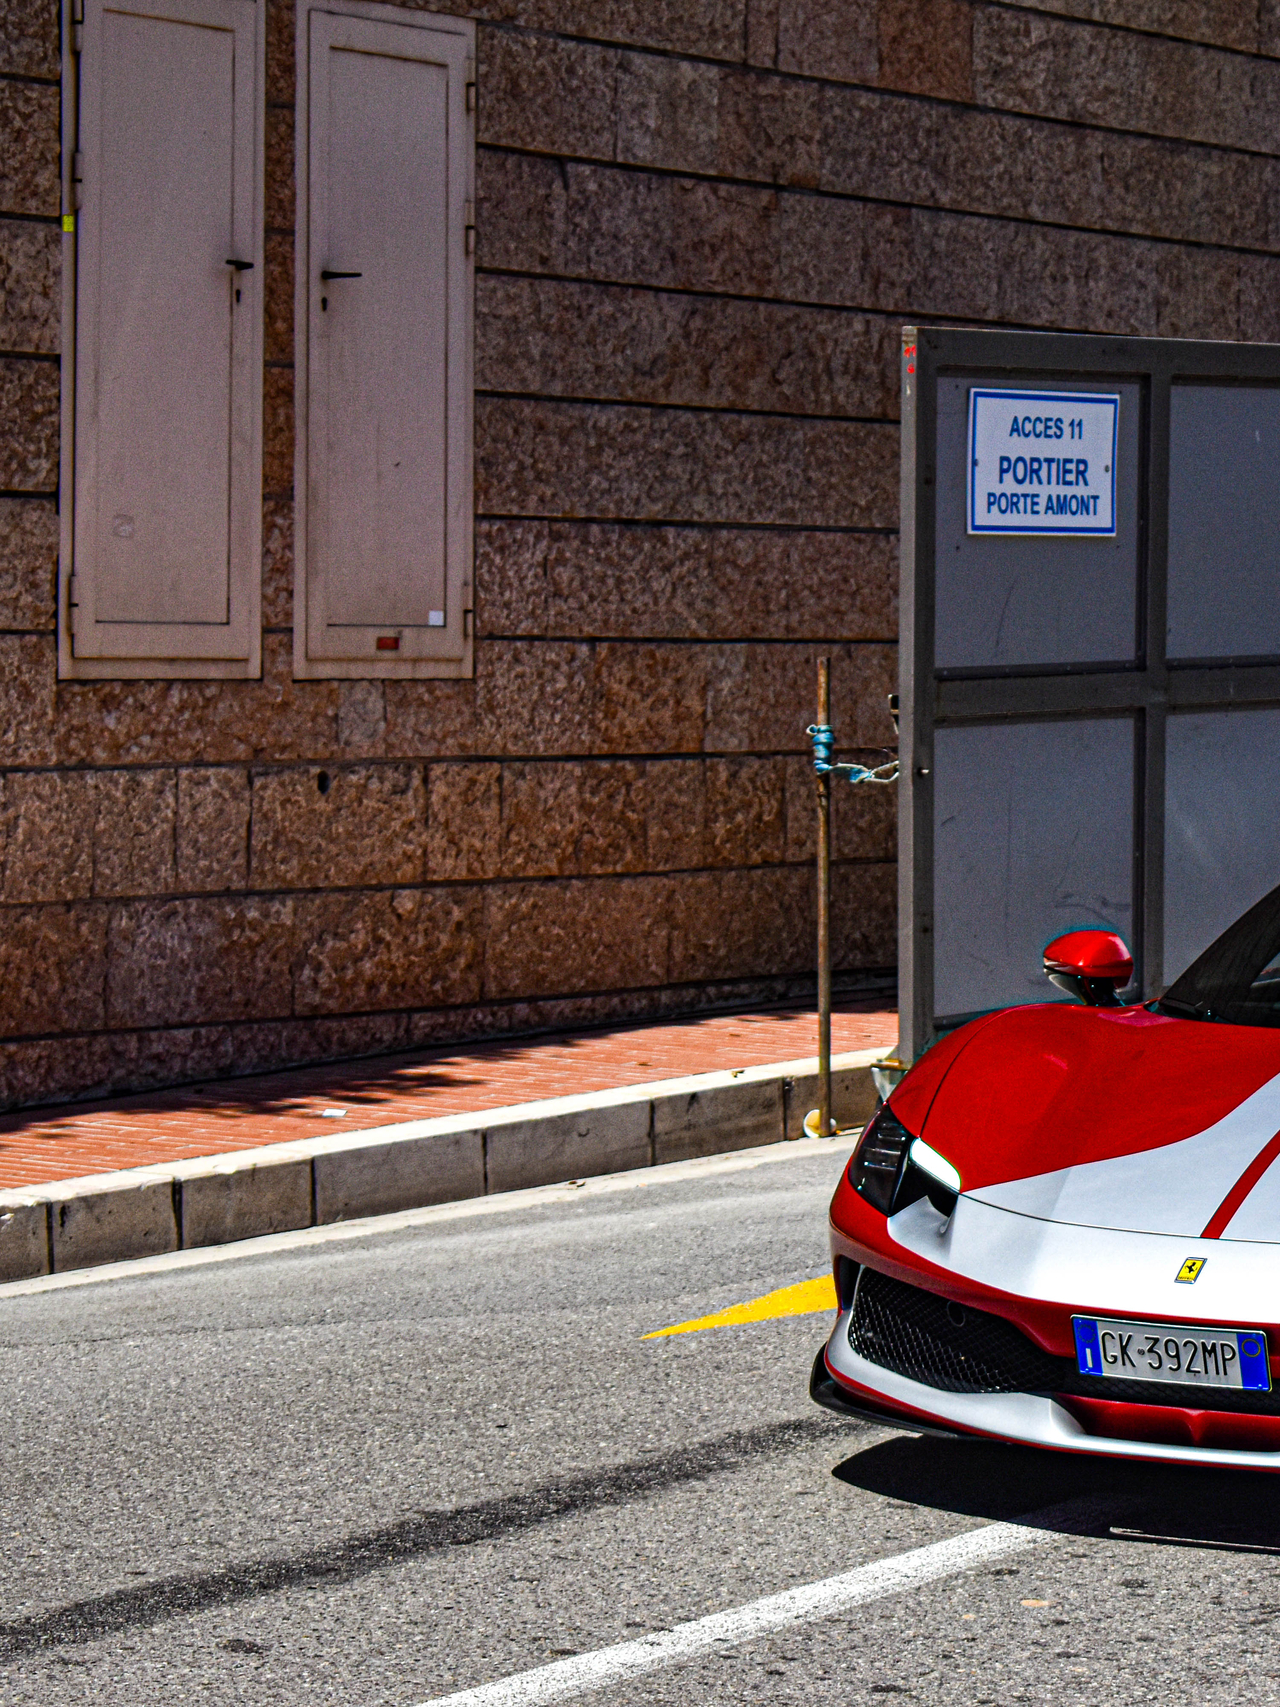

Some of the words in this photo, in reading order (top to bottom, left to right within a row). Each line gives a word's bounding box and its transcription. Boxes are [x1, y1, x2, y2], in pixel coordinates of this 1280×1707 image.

[1009, 416, 1064, 439] ACCES
[1068, 418, 1083, 440] 11
[999, 455, 1089, 487] PORTIER
[987, 492, 1041, 515] PORTE
[1044, 494, 1100, 516] AMONT
